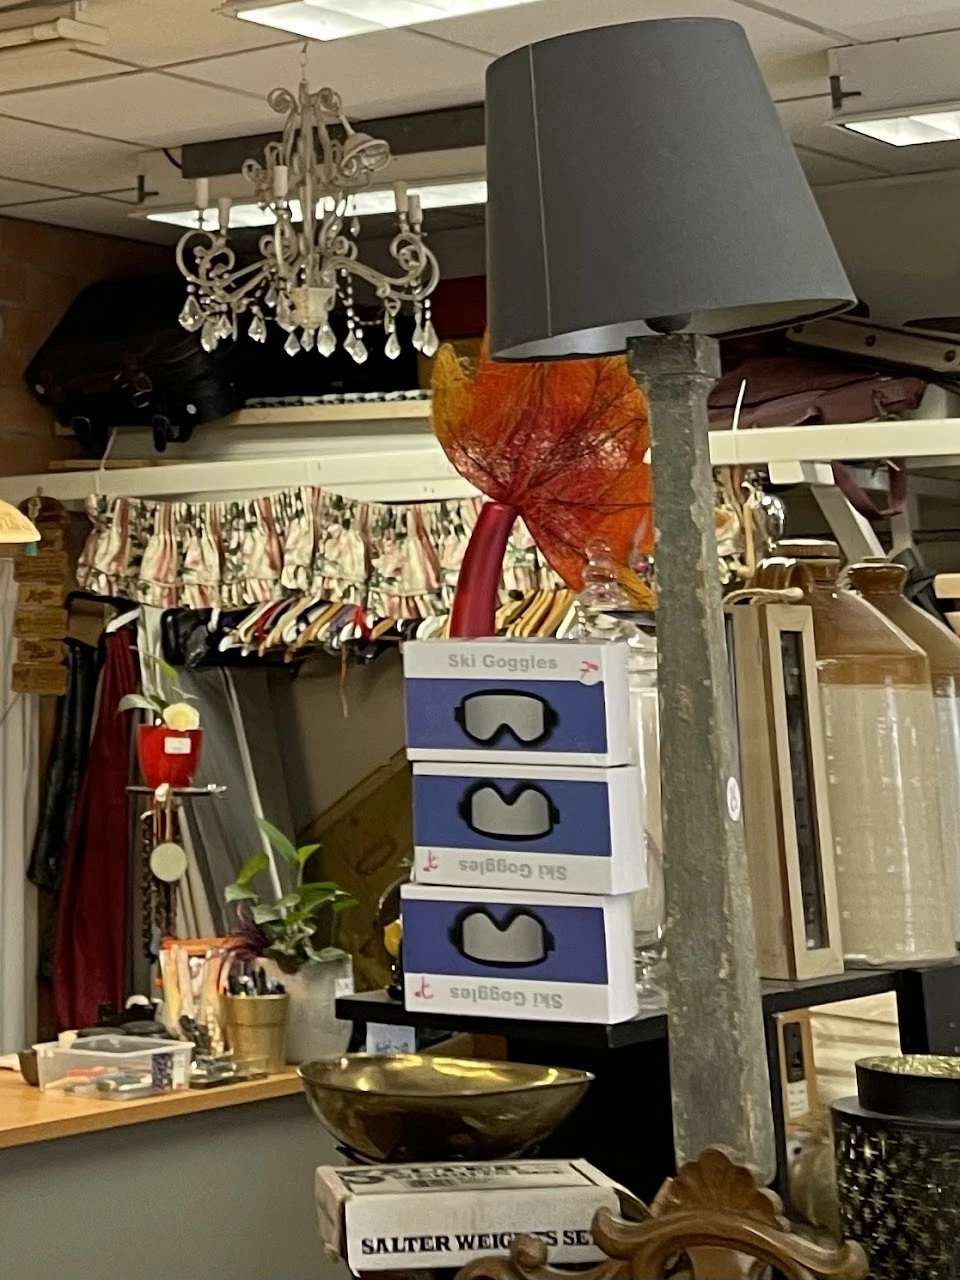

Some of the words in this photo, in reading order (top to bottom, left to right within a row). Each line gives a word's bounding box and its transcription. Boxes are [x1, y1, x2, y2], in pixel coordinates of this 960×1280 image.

[448, 654, 476, 668] Ski
[483, 654, 558, 672] Goggles
[458, 857, 533, 878] Goggles
[539, 864, 568, 881] Ski
[449, 985, 526, 1007] Goggles
[533, 991, 563, 1009] Ski
[361, 1234, 452, 1255] SALTER
[454, 1230, 558, 1250] WEIGS
